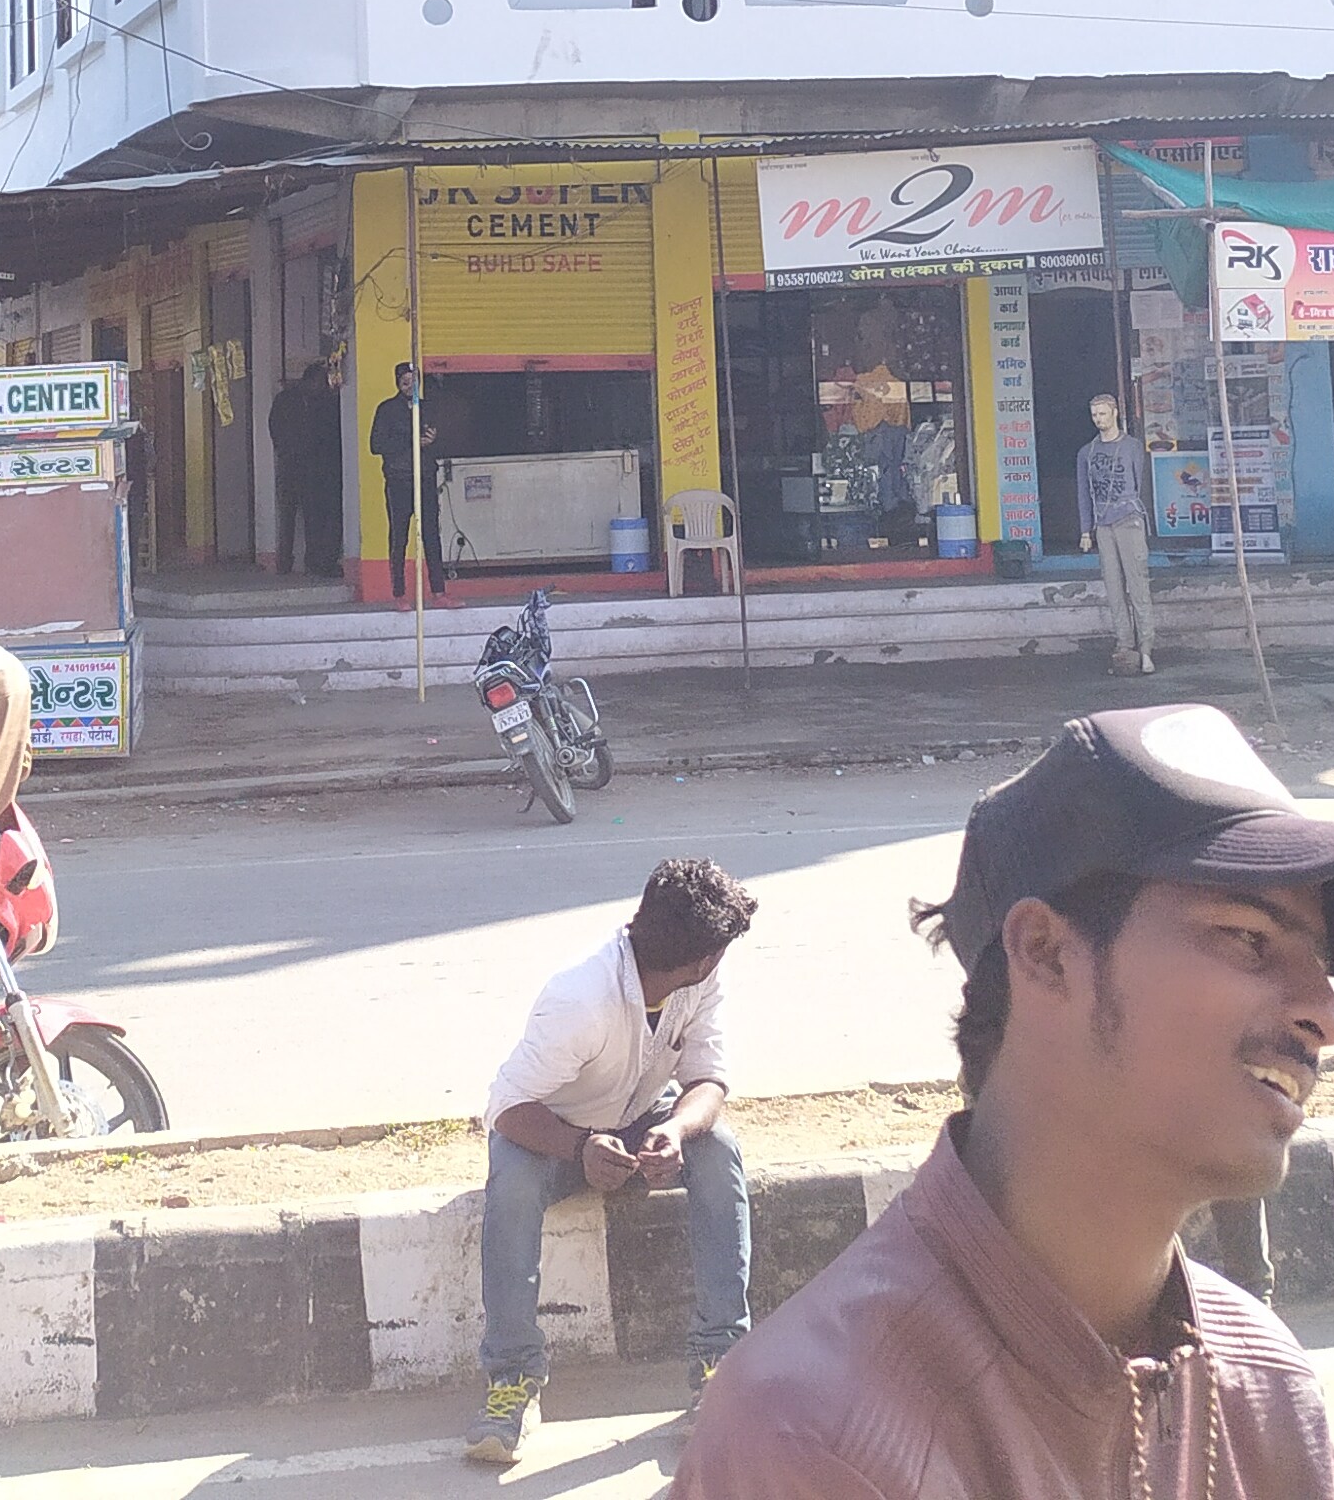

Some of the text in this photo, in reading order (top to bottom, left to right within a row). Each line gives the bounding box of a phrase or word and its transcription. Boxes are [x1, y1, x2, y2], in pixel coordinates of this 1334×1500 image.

[778, 163, 1065, 249] m2m
[467, 213, 600, 237] CEMENT
[467, 253, 603, 273] BUILD SAFE
[860, 249, 876, 261] We
[880, 248, 911, 260] Want
[1227, 244, 1282, 281] RK
[849, 265, 886, 281] ओम
[952, 259, 974, 273] की
[979, 256, 1025, 275] दुकान
[999, 300, 1018, 313] कार्ड
[1001, 335, 1020, 348] कार्ड
[1003, 374, 1022, 386] कार्ड
[7, 381, 100, 414] CENTER
[11, 454, 93, 476] સેન્ટર
[1004, 472, 1031, 482] नकल
[51, 662, 116, 673] M. 7410191544
